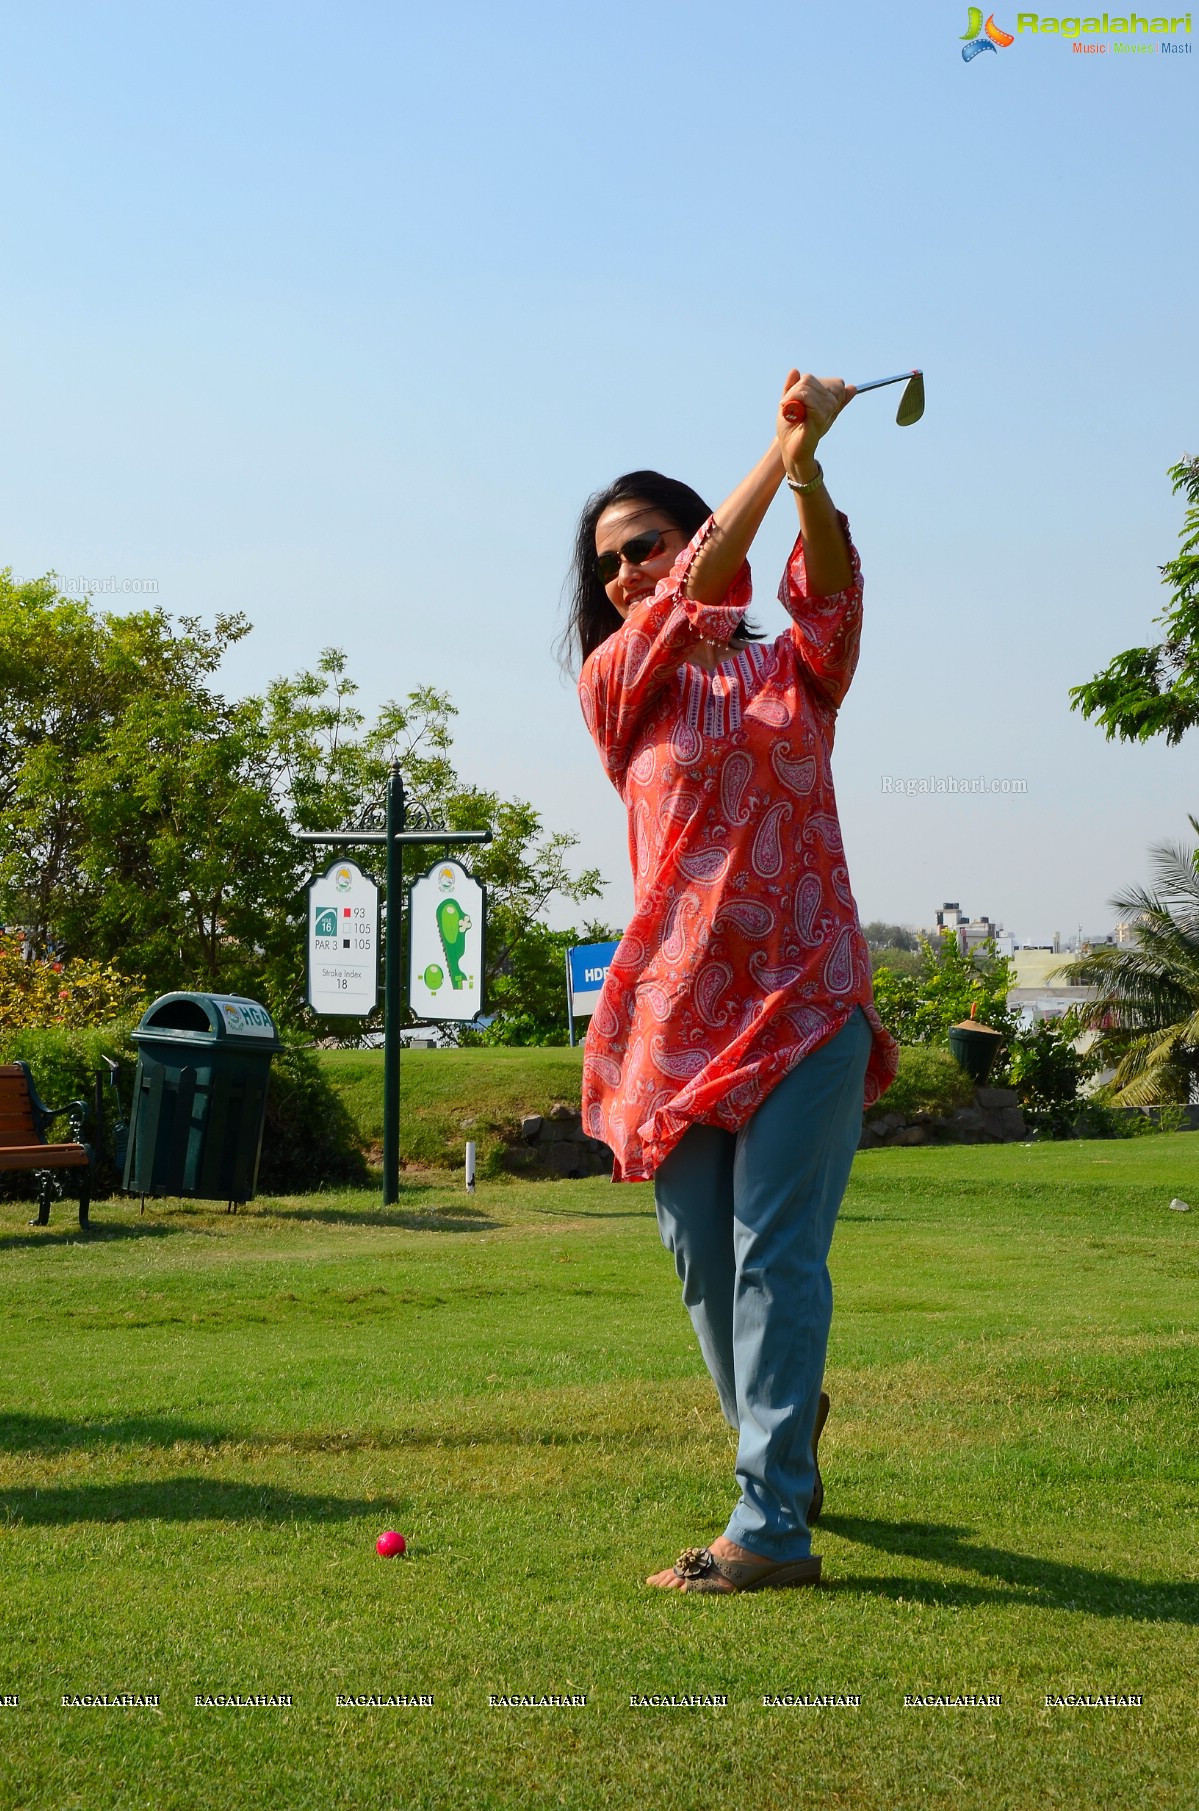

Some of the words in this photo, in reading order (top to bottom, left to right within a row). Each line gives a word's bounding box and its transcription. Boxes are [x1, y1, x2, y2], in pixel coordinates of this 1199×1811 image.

[353, 907, 366, 919] 93
[321, 922, 332, 932] 16
[354, 923, 371, 934] 105
[315, 939, 330, 950] PAR
[332, 940, 338, 950] 3
[354, 939, 371, 950] 105
[322, 968, 342, 978] Stroke
[344, 969, 362, 979] Index
[336, 978, 348, 989] 18
[238, 1006, 273, 1028] HGA
